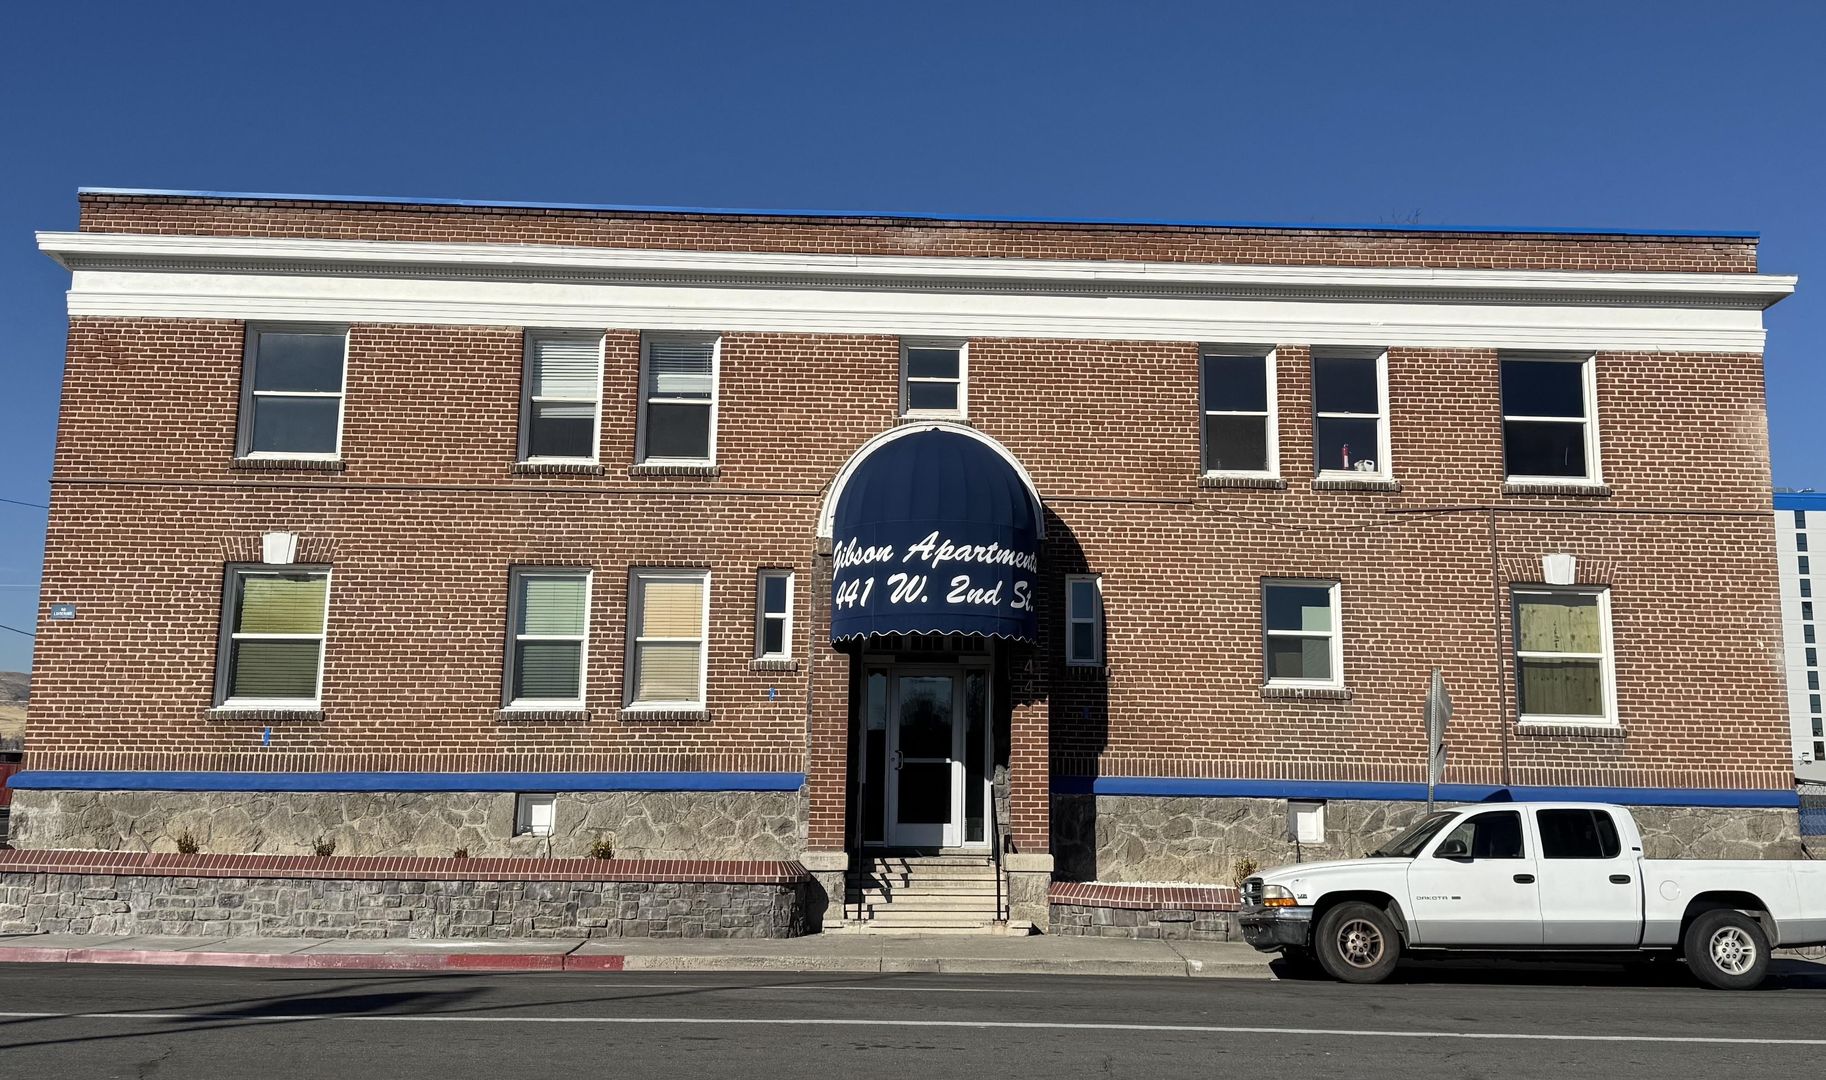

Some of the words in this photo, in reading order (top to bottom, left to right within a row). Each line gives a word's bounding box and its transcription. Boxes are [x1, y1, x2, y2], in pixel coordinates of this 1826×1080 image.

[833, 536, 894, 580] Gibson
[902, 530, 1037, 574] Apartments
[836, 576, 875, 610] 441
[887, 572, 928, 604] W.
[946, 574, 1003, 606] 2nd
[1010, 580, 1034, 612] St.
